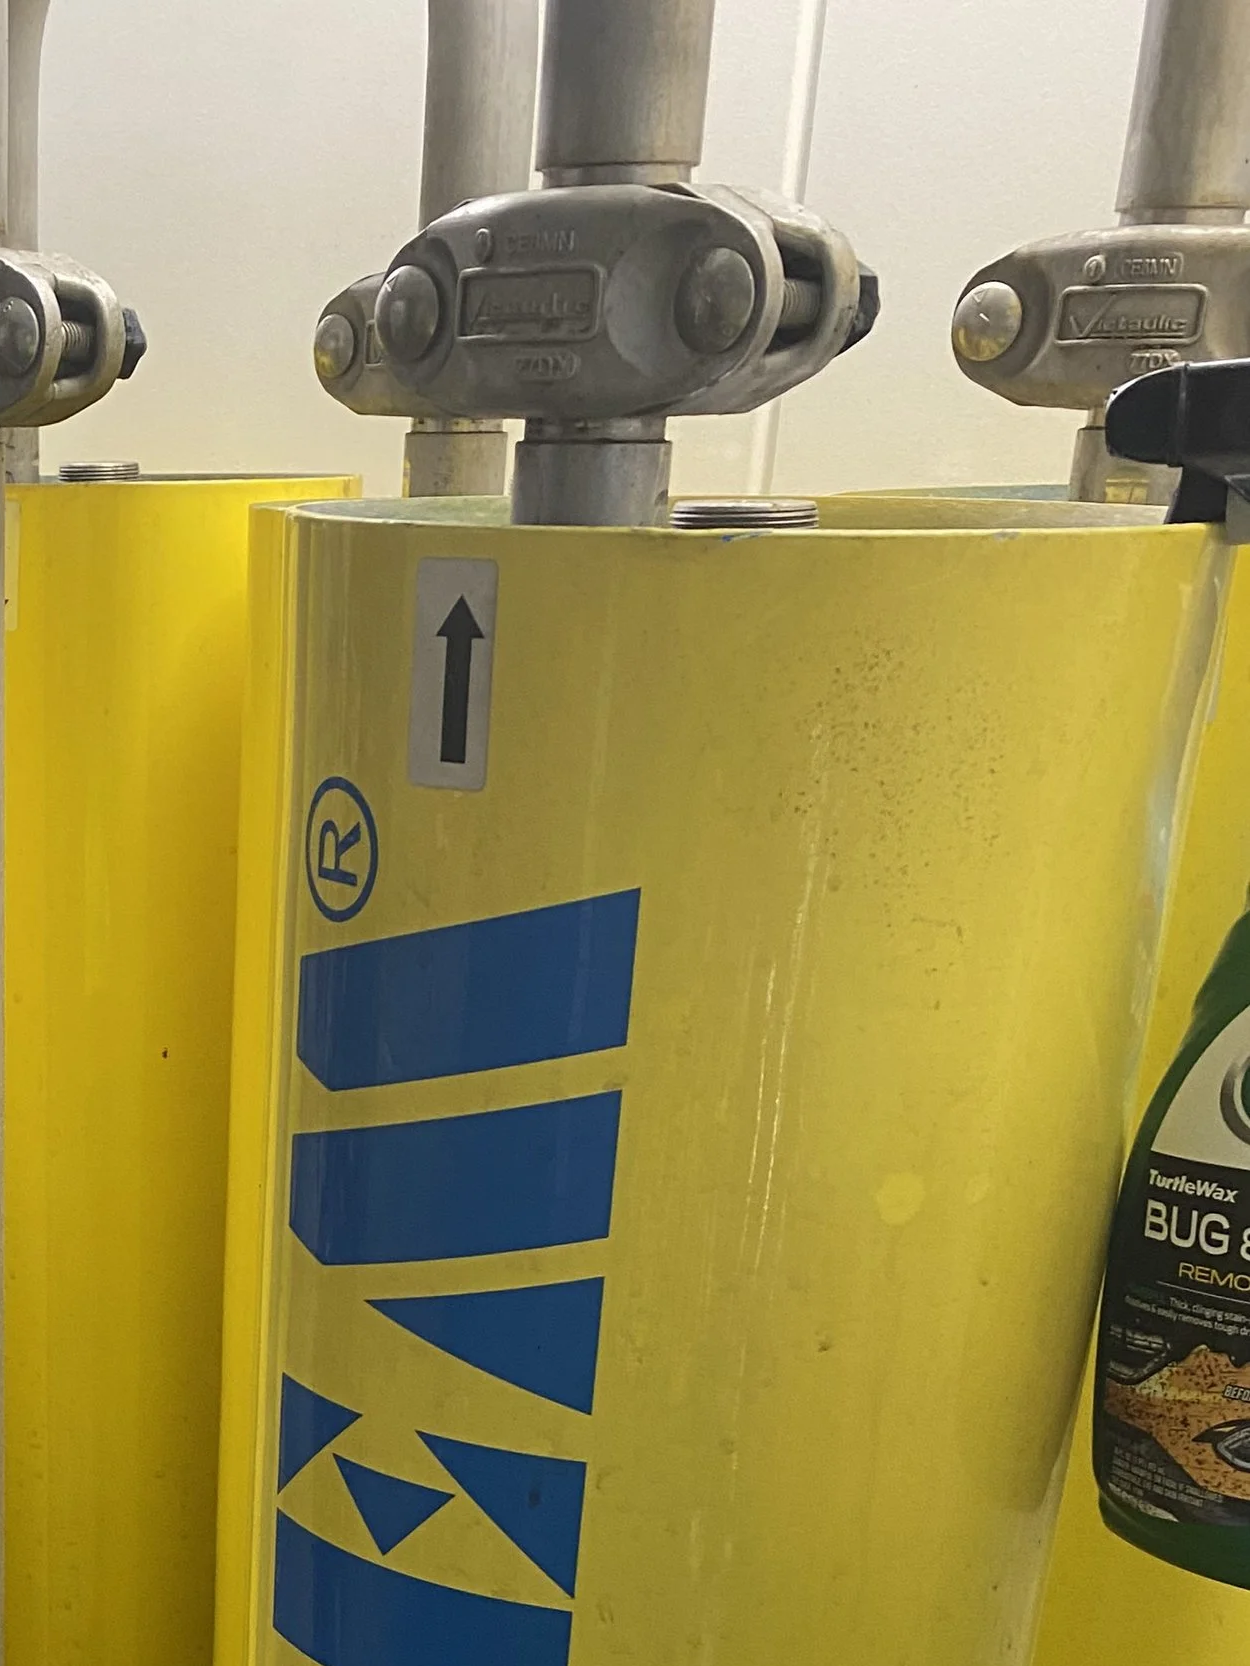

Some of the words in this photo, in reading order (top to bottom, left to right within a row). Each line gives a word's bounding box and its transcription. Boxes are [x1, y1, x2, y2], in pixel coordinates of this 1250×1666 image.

[1070, 293, 1188, 337] Victaulic
[1144, 1199, 1231, 1255] BUG
[1214, 1321, 1239, 1336] tough
